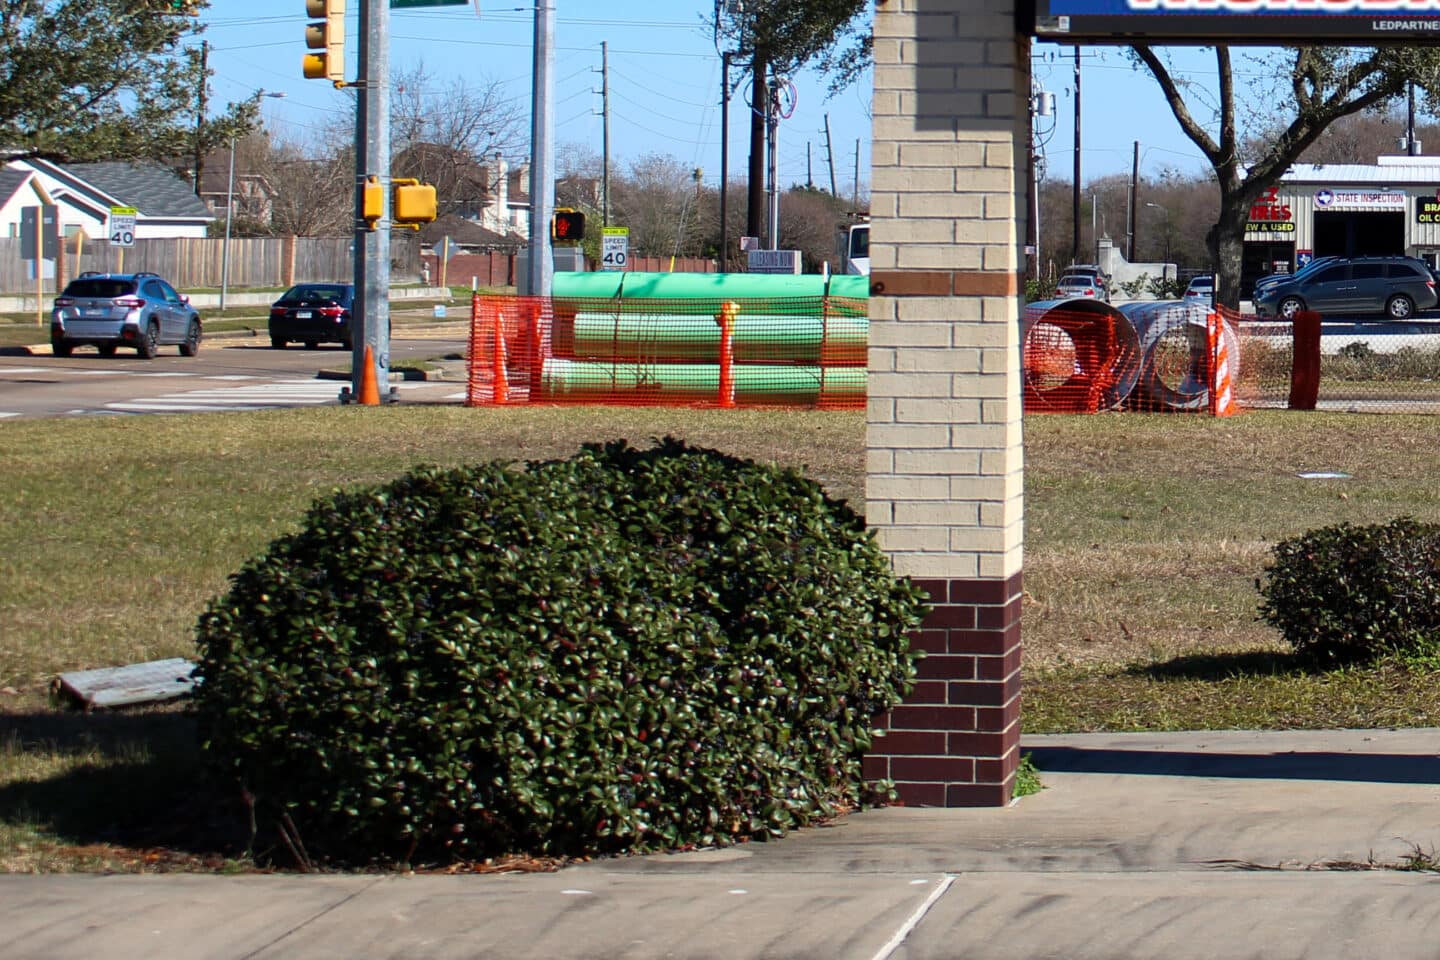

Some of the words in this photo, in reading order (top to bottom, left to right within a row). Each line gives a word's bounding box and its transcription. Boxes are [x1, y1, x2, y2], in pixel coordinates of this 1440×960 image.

[1336, 193, 1359, 203] STATE
[1361, 193, 1404, 203] INSPECTION
[1250, 205, 1292, 221] IRES
[1419, 214, 1433, 223] OIL
[1245, 223, 1259, 231] EW
[1271, 223, 1294, 231] USED
[112, 232, 133, 243] 40
[604, 253, 625, 264] 40
